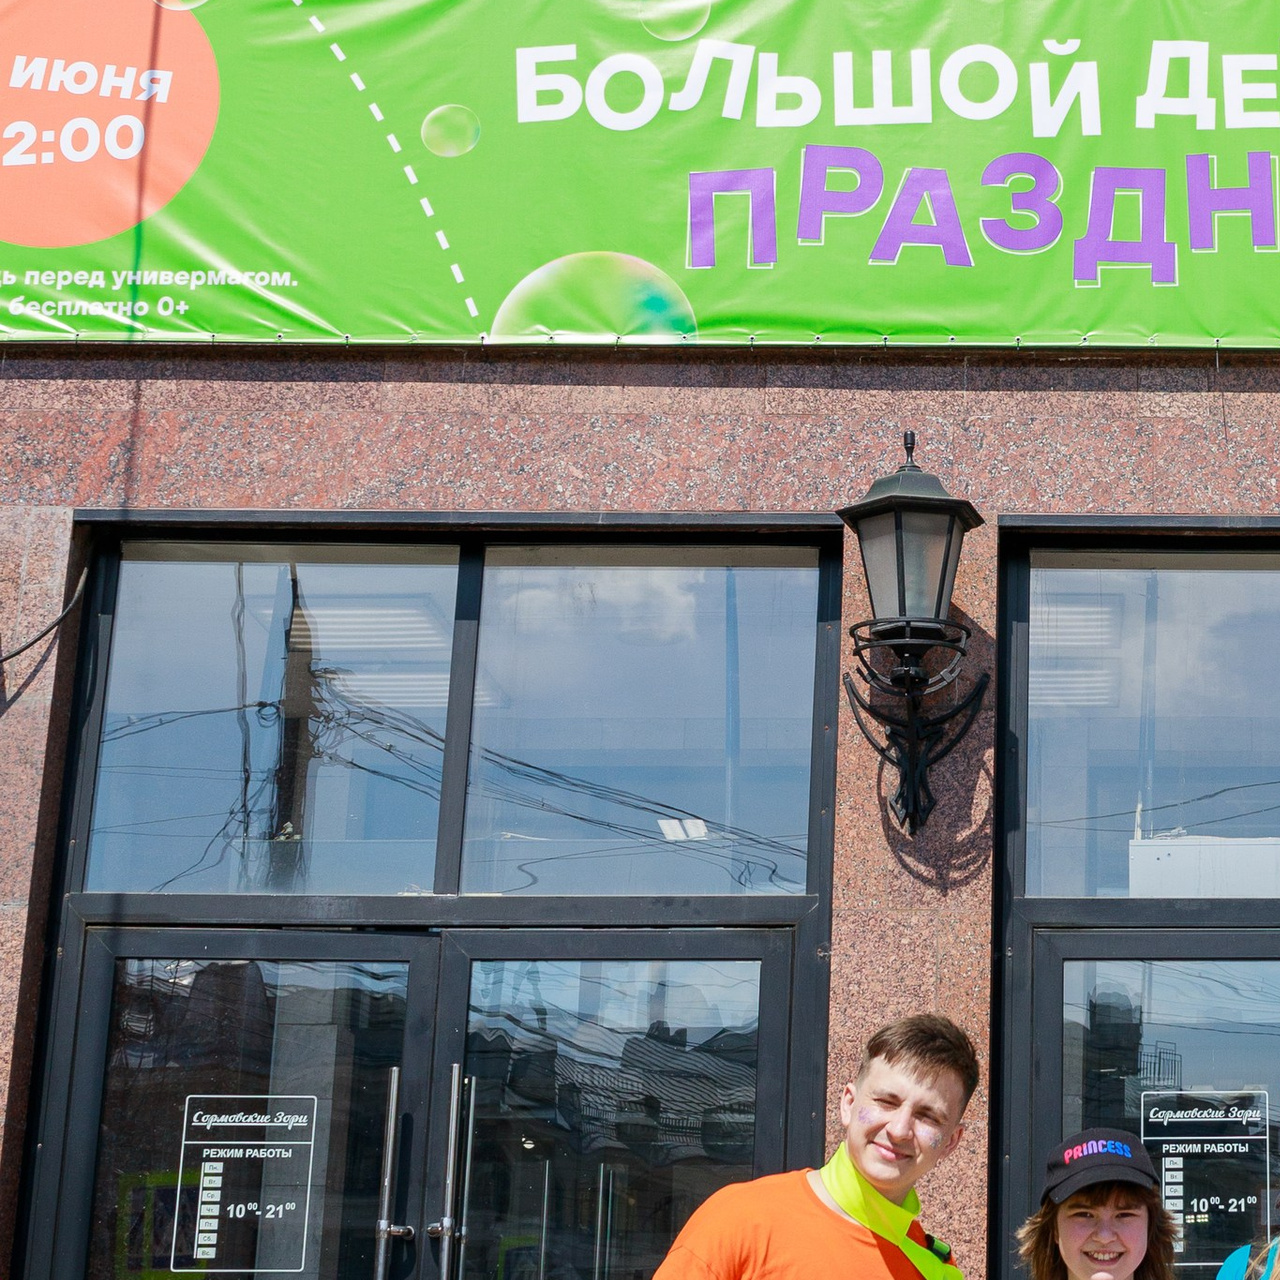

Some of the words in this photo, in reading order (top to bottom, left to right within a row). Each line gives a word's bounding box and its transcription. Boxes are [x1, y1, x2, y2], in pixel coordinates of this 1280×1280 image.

[515, 37, 1102, 138] БОЛЬШОЙ
[24, 270, 105, 291] перед
[111, 270, 299, 291] универмагом.
[8, 295, 149, 317] бесплатно
[157, 296, 190, 317] 0+
[192, 1111, 271, 1130] Сормовские
[273, 1111, 309, 1131] Зори
[1149, 1107, 1225, 1126] Сормовские
[1228, 1106, 1261, 1125] Зори
[203, 1148, 244, 1158] РЕЖИМ
[245, 1148, 292, 1158] РАБОТЫ
[1064, 1140, 1132, 1165] PRINCESS
[1162, 1144, 1201, 1153] РЕЖИМ
[1203, 1143, 1249, 1153] РАБОТЫ
